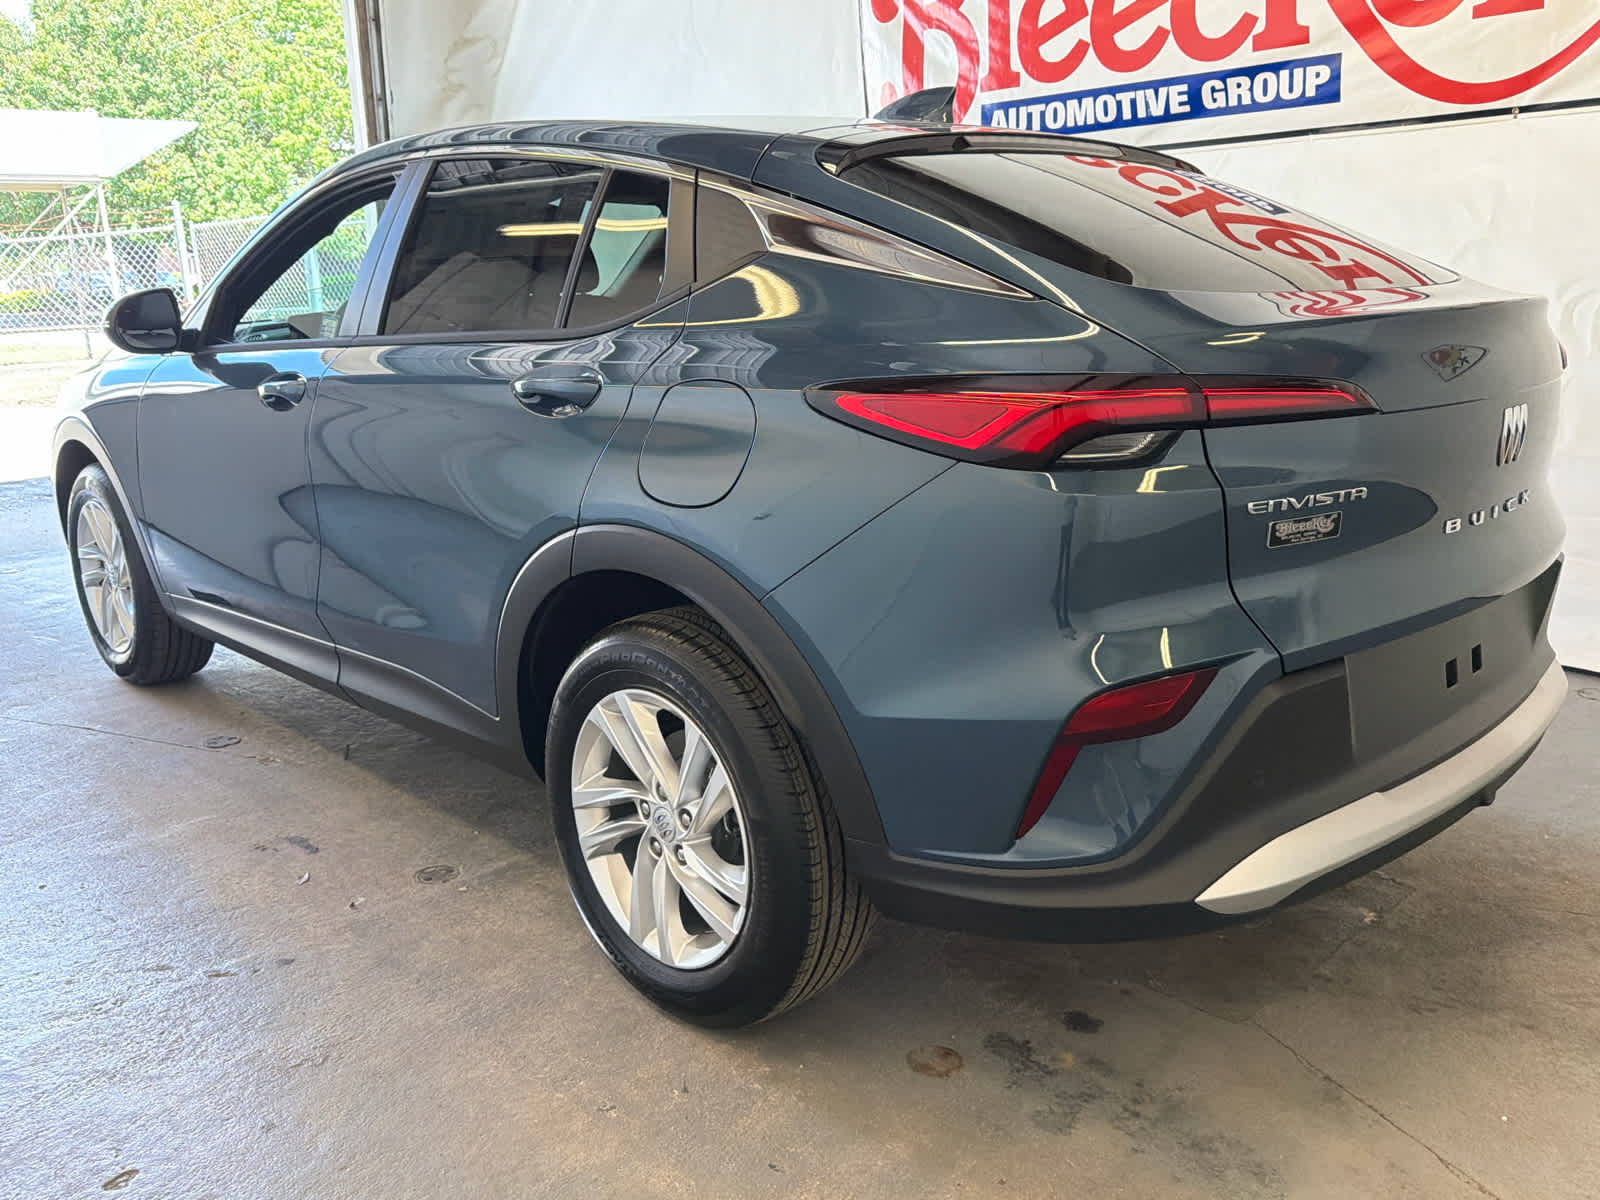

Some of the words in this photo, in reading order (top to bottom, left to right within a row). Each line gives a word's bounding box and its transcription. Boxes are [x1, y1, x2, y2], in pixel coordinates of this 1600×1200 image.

[990, 83, 1190, 131] AUTOMOTIVE
[1202, 64, 1332, 110] GROUP
[1248, 487, 1368, 514] ENVISTA
[1442, 489, 1529, 534] BUICK
